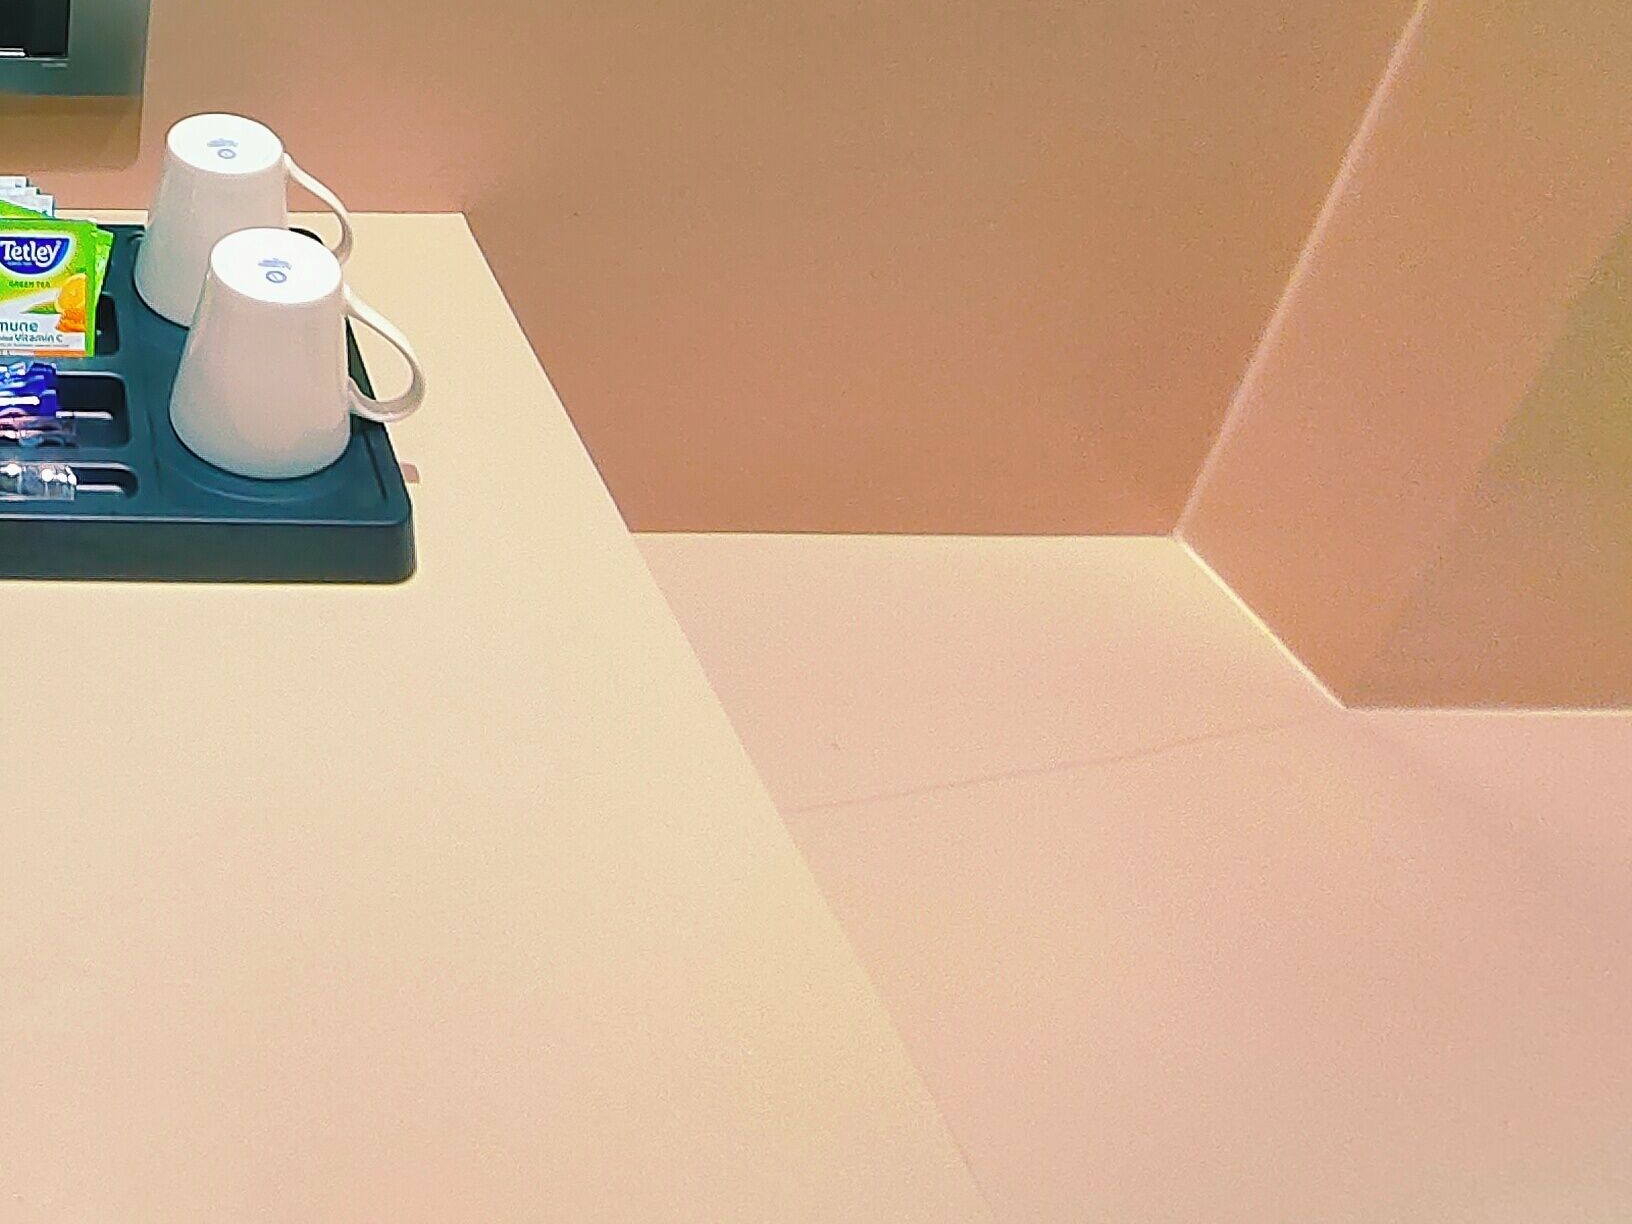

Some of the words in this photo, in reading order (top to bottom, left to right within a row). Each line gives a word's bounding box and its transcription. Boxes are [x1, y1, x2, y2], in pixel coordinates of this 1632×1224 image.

[0, 240, 62, 268] Tetley
[9, 280, 35, 288] GREEN
[36, 280, 51, 288] TEA
[14, 334, 55, 343] Vitamin
[56, 334, 63, 343] C
